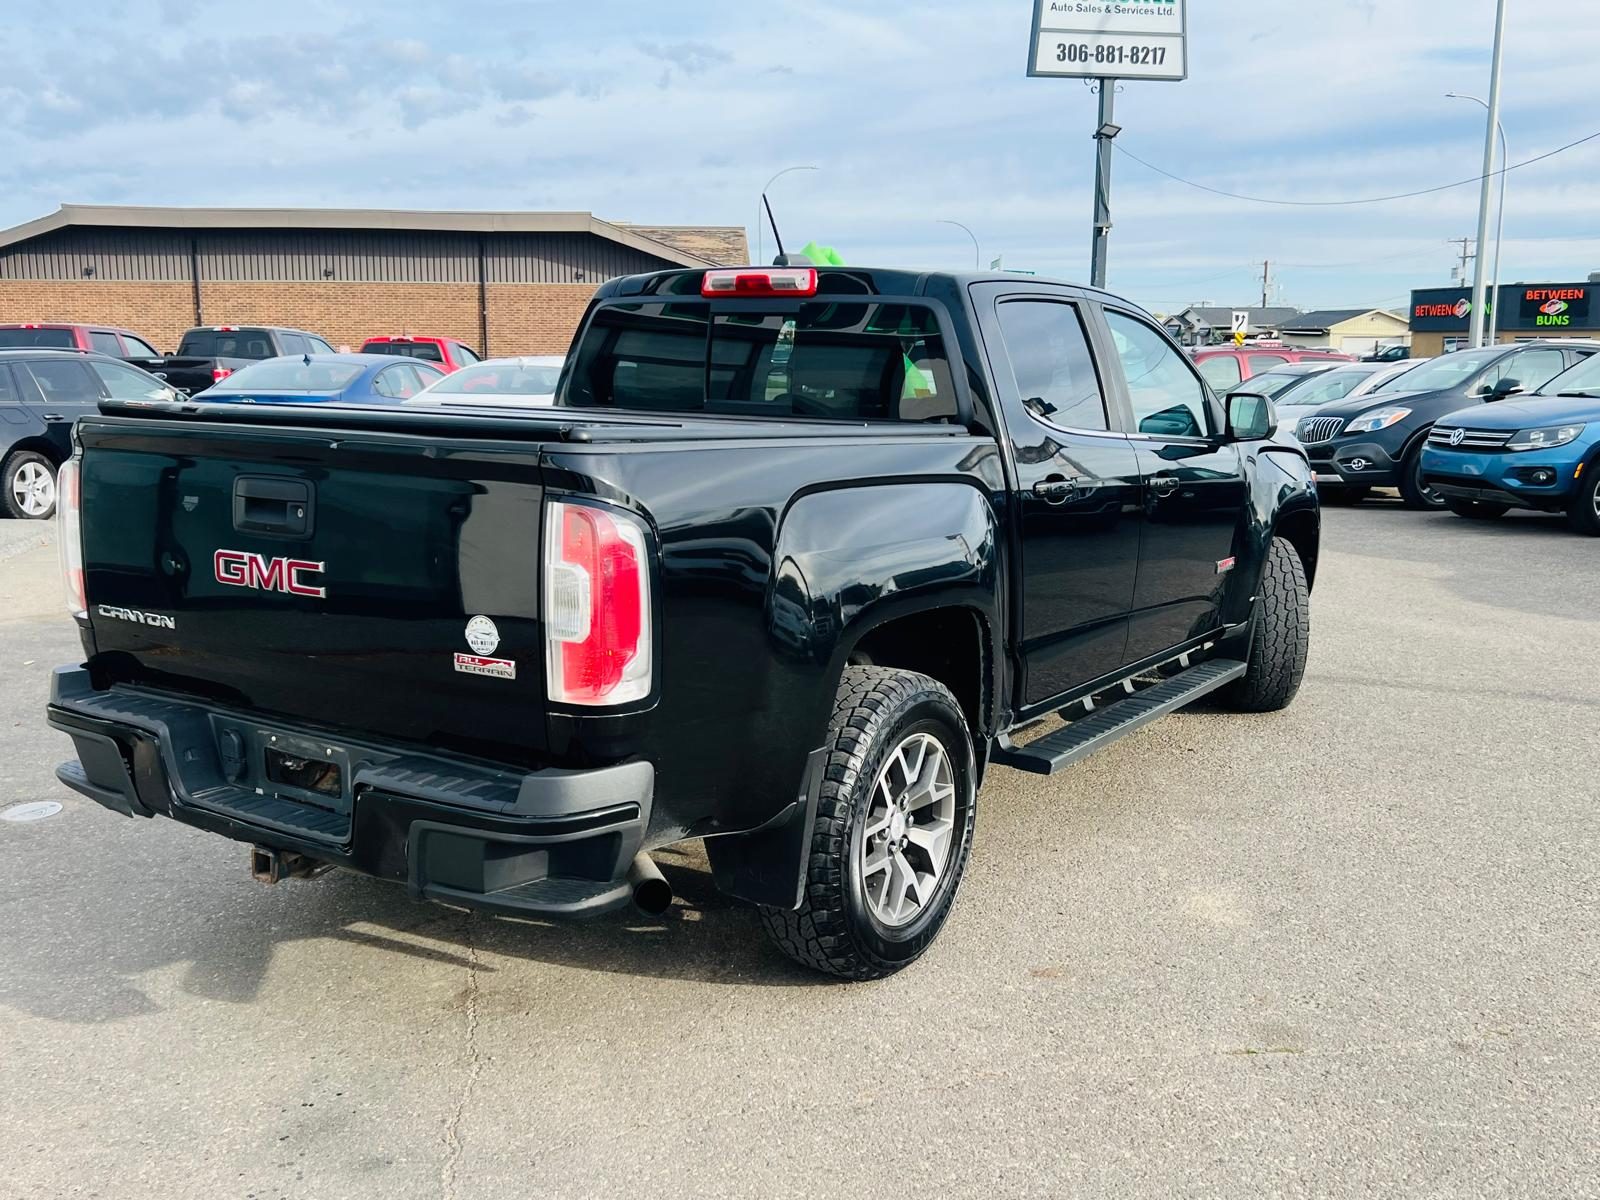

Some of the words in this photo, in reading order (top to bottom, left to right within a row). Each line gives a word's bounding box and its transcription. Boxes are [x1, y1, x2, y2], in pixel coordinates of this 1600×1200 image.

[1050, 2, 1073, 12] Auto
[1075, 3, 1102, 14] Sales
[1104, 4, 1112, 14] &
[1114, 5, 1155, 16] Services
[1157, 7, 1175, 16] Ltd.
[1056, 43, 1166, 65] 306-881-8217
[1526, 289, 1584, 300] BETWEEN
[1415, 304, 1452, 317] BETWEEN
[1536, 315, 1570, 326] BUNS
[214, 548, 326, 598] GMC
[98, 604, 176, 629] CANYON
[457, 664, 513, 678] TERRAIN
